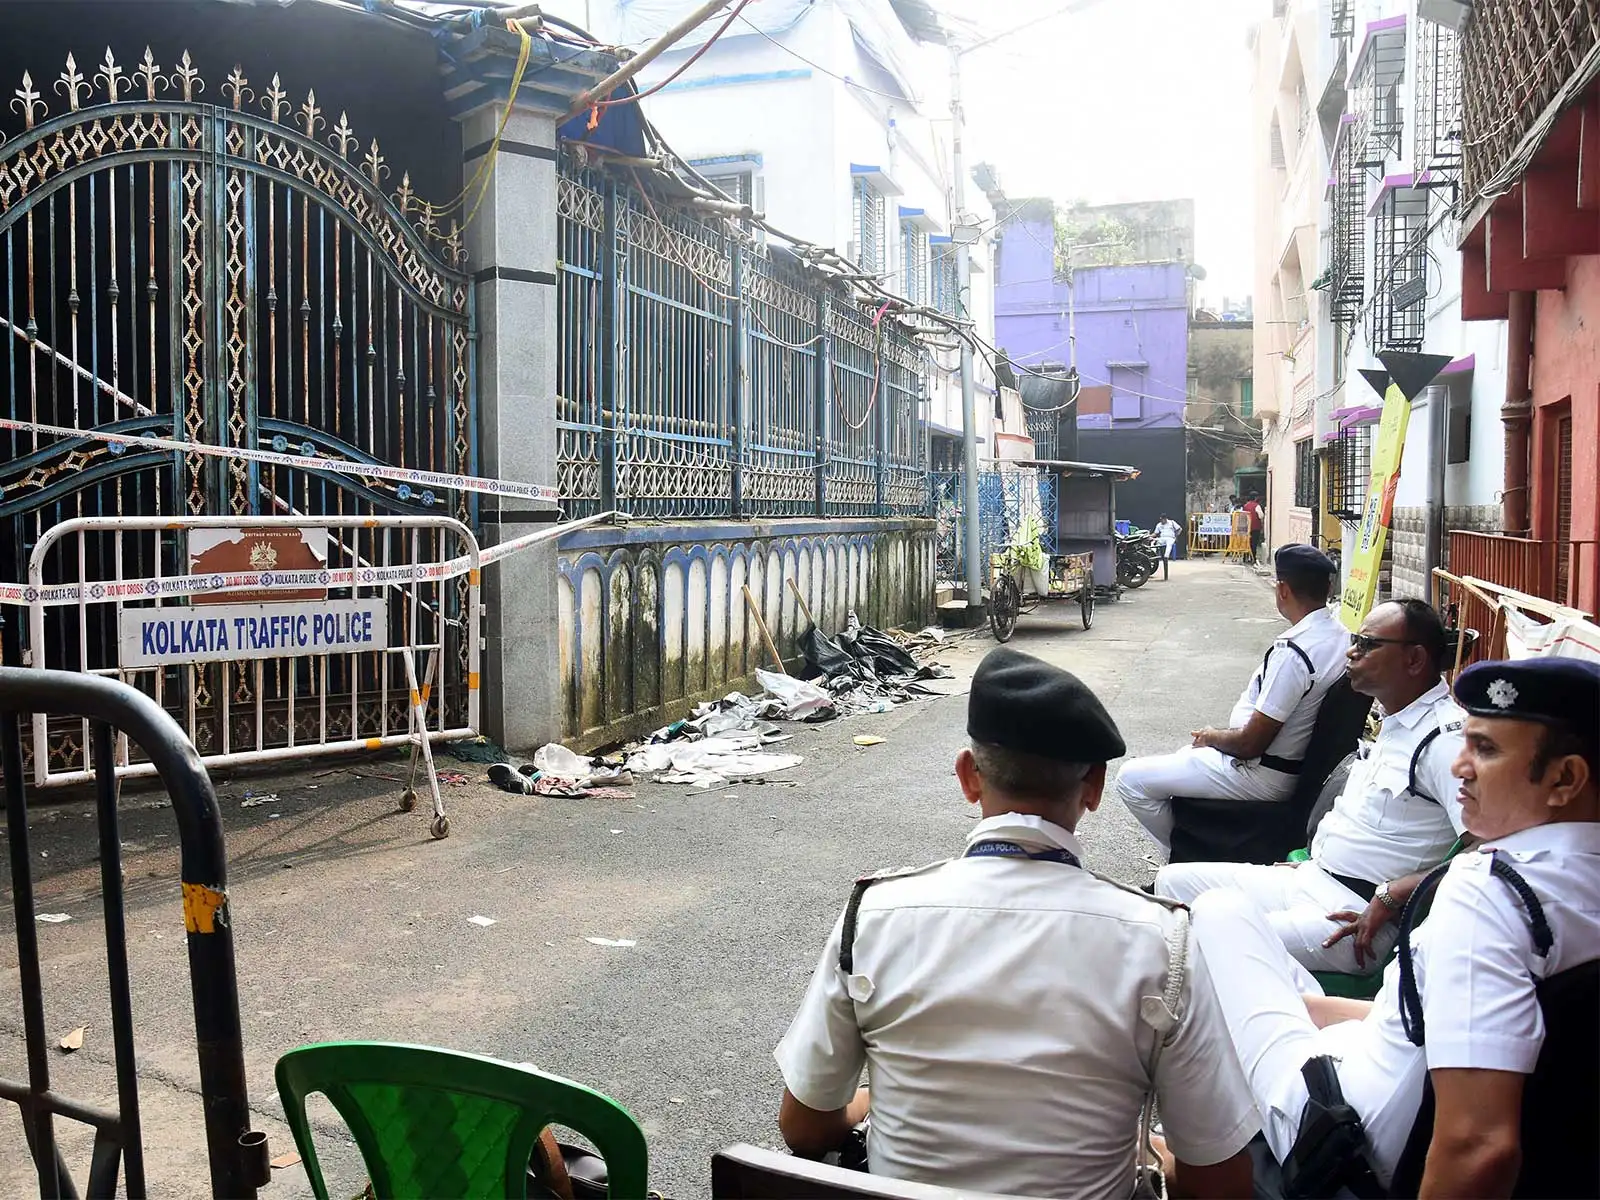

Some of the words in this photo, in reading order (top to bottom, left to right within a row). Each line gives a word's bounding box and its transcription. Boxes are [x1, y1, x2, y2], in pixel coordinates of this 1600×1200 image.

[439, 476, 453, 485] POLICE
[499, 484, 515, 493] KOLKATA
[516, 486, 529, 494] POLICE
[332, 572, 339, 582] DO
[339, 572, 347, 582] NOT
[376, 569, 398, 581] KOLKATA
[398, 568, 413, 579] POLICE
[428, 567, 435, 577] DO
[435, 566, 444, 577] NOT
[225, 576, 232, 587] DO
[233, 576, 243, 587] NOT
[243, 575, 258, 586] CROSS
[274, 573, 299, 584] KOLKATA
[299, 573, 317, 584] POLICE
[107, 585, 114, 596] DO
[115, 584, 126, 595] NOT
[127, 583, 144, 595] CROSS
[161, 580, 187, 592] KOLKATA
[188, 578, 208, 590] POLICE
[6, 588, 21, 599] CROSS
[39, 588, 66, 600] KOLKATA
[142, 618, 230, 656] KOLKATA
[233, 614, 308, 651] TRAFFIC
[313, 611, 373, 646] POLICE
